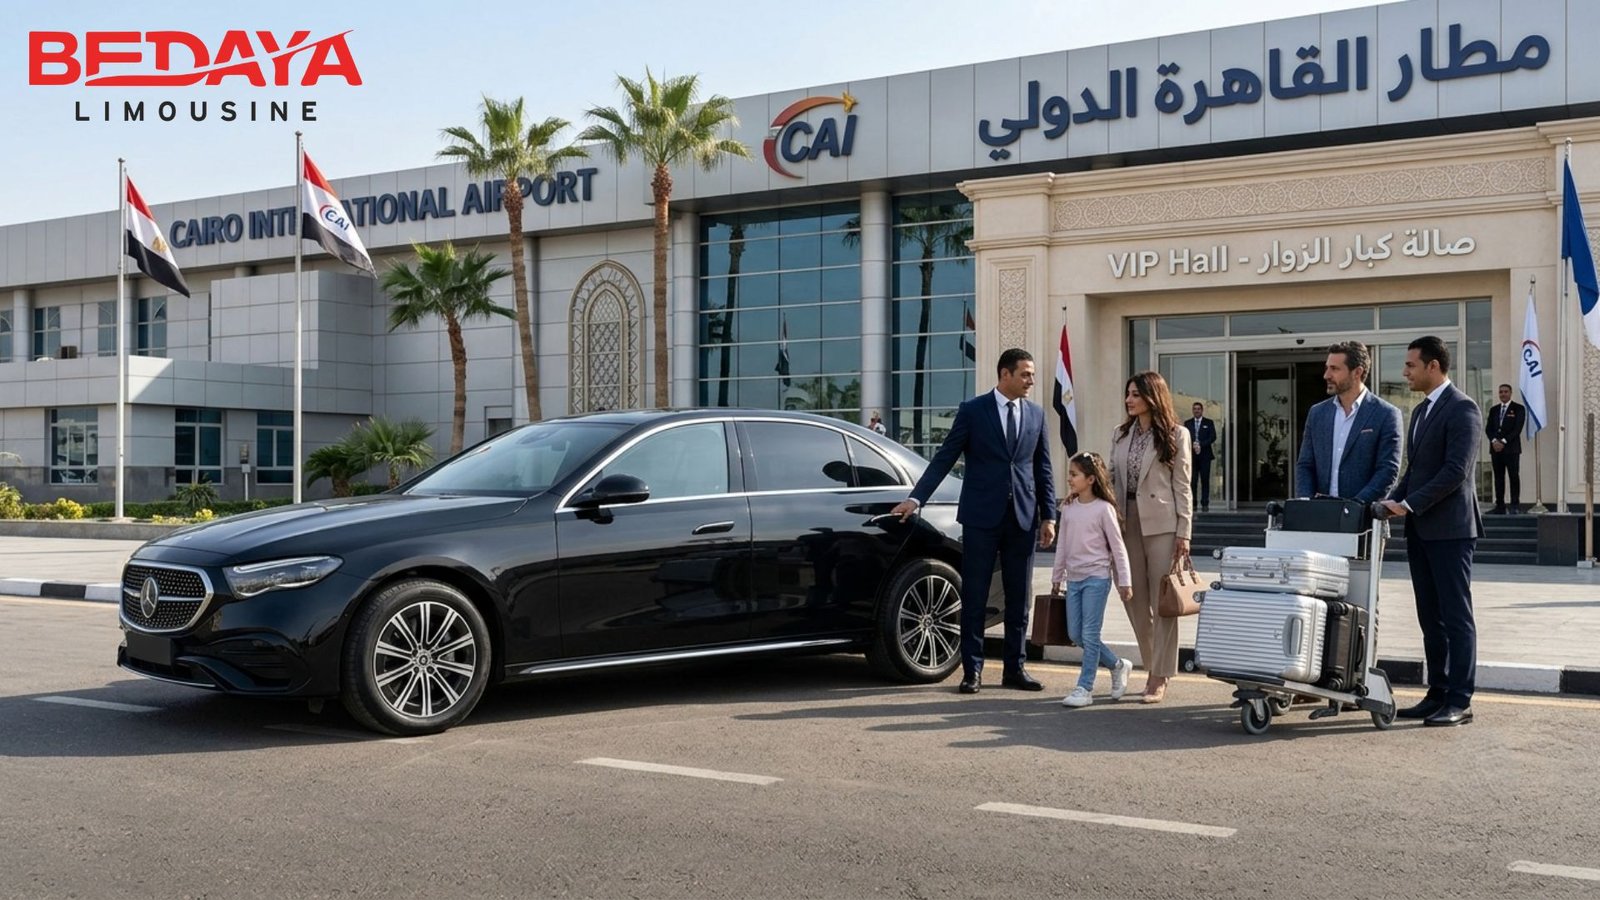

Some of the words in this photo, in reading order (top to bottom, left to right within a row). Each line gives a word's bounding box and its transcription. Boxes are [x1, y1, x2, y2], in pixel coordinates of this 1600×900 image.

[1154, 35, 1368, 126] القاهرة
[1386, 23, 1551, 102] مطار
[979, 67, 1138, 161] الدولي
[781, 114, 858, 163] CAI
[169, 213, 244, 249] CAIRO
[249, 187, 456, 240] INTTIONAL
[325, 209, 350, 231] CAI
[1169, 245, 1229, 275] Hall
[1256, 237, 1331, 275] الزوار
[1338, 232, 1393, 269] كبار
[1402, 229, 1476, 257] صالة
[1107, 251, 1160, 279] VIP
[1523, 348, 1543, 378] CAI
